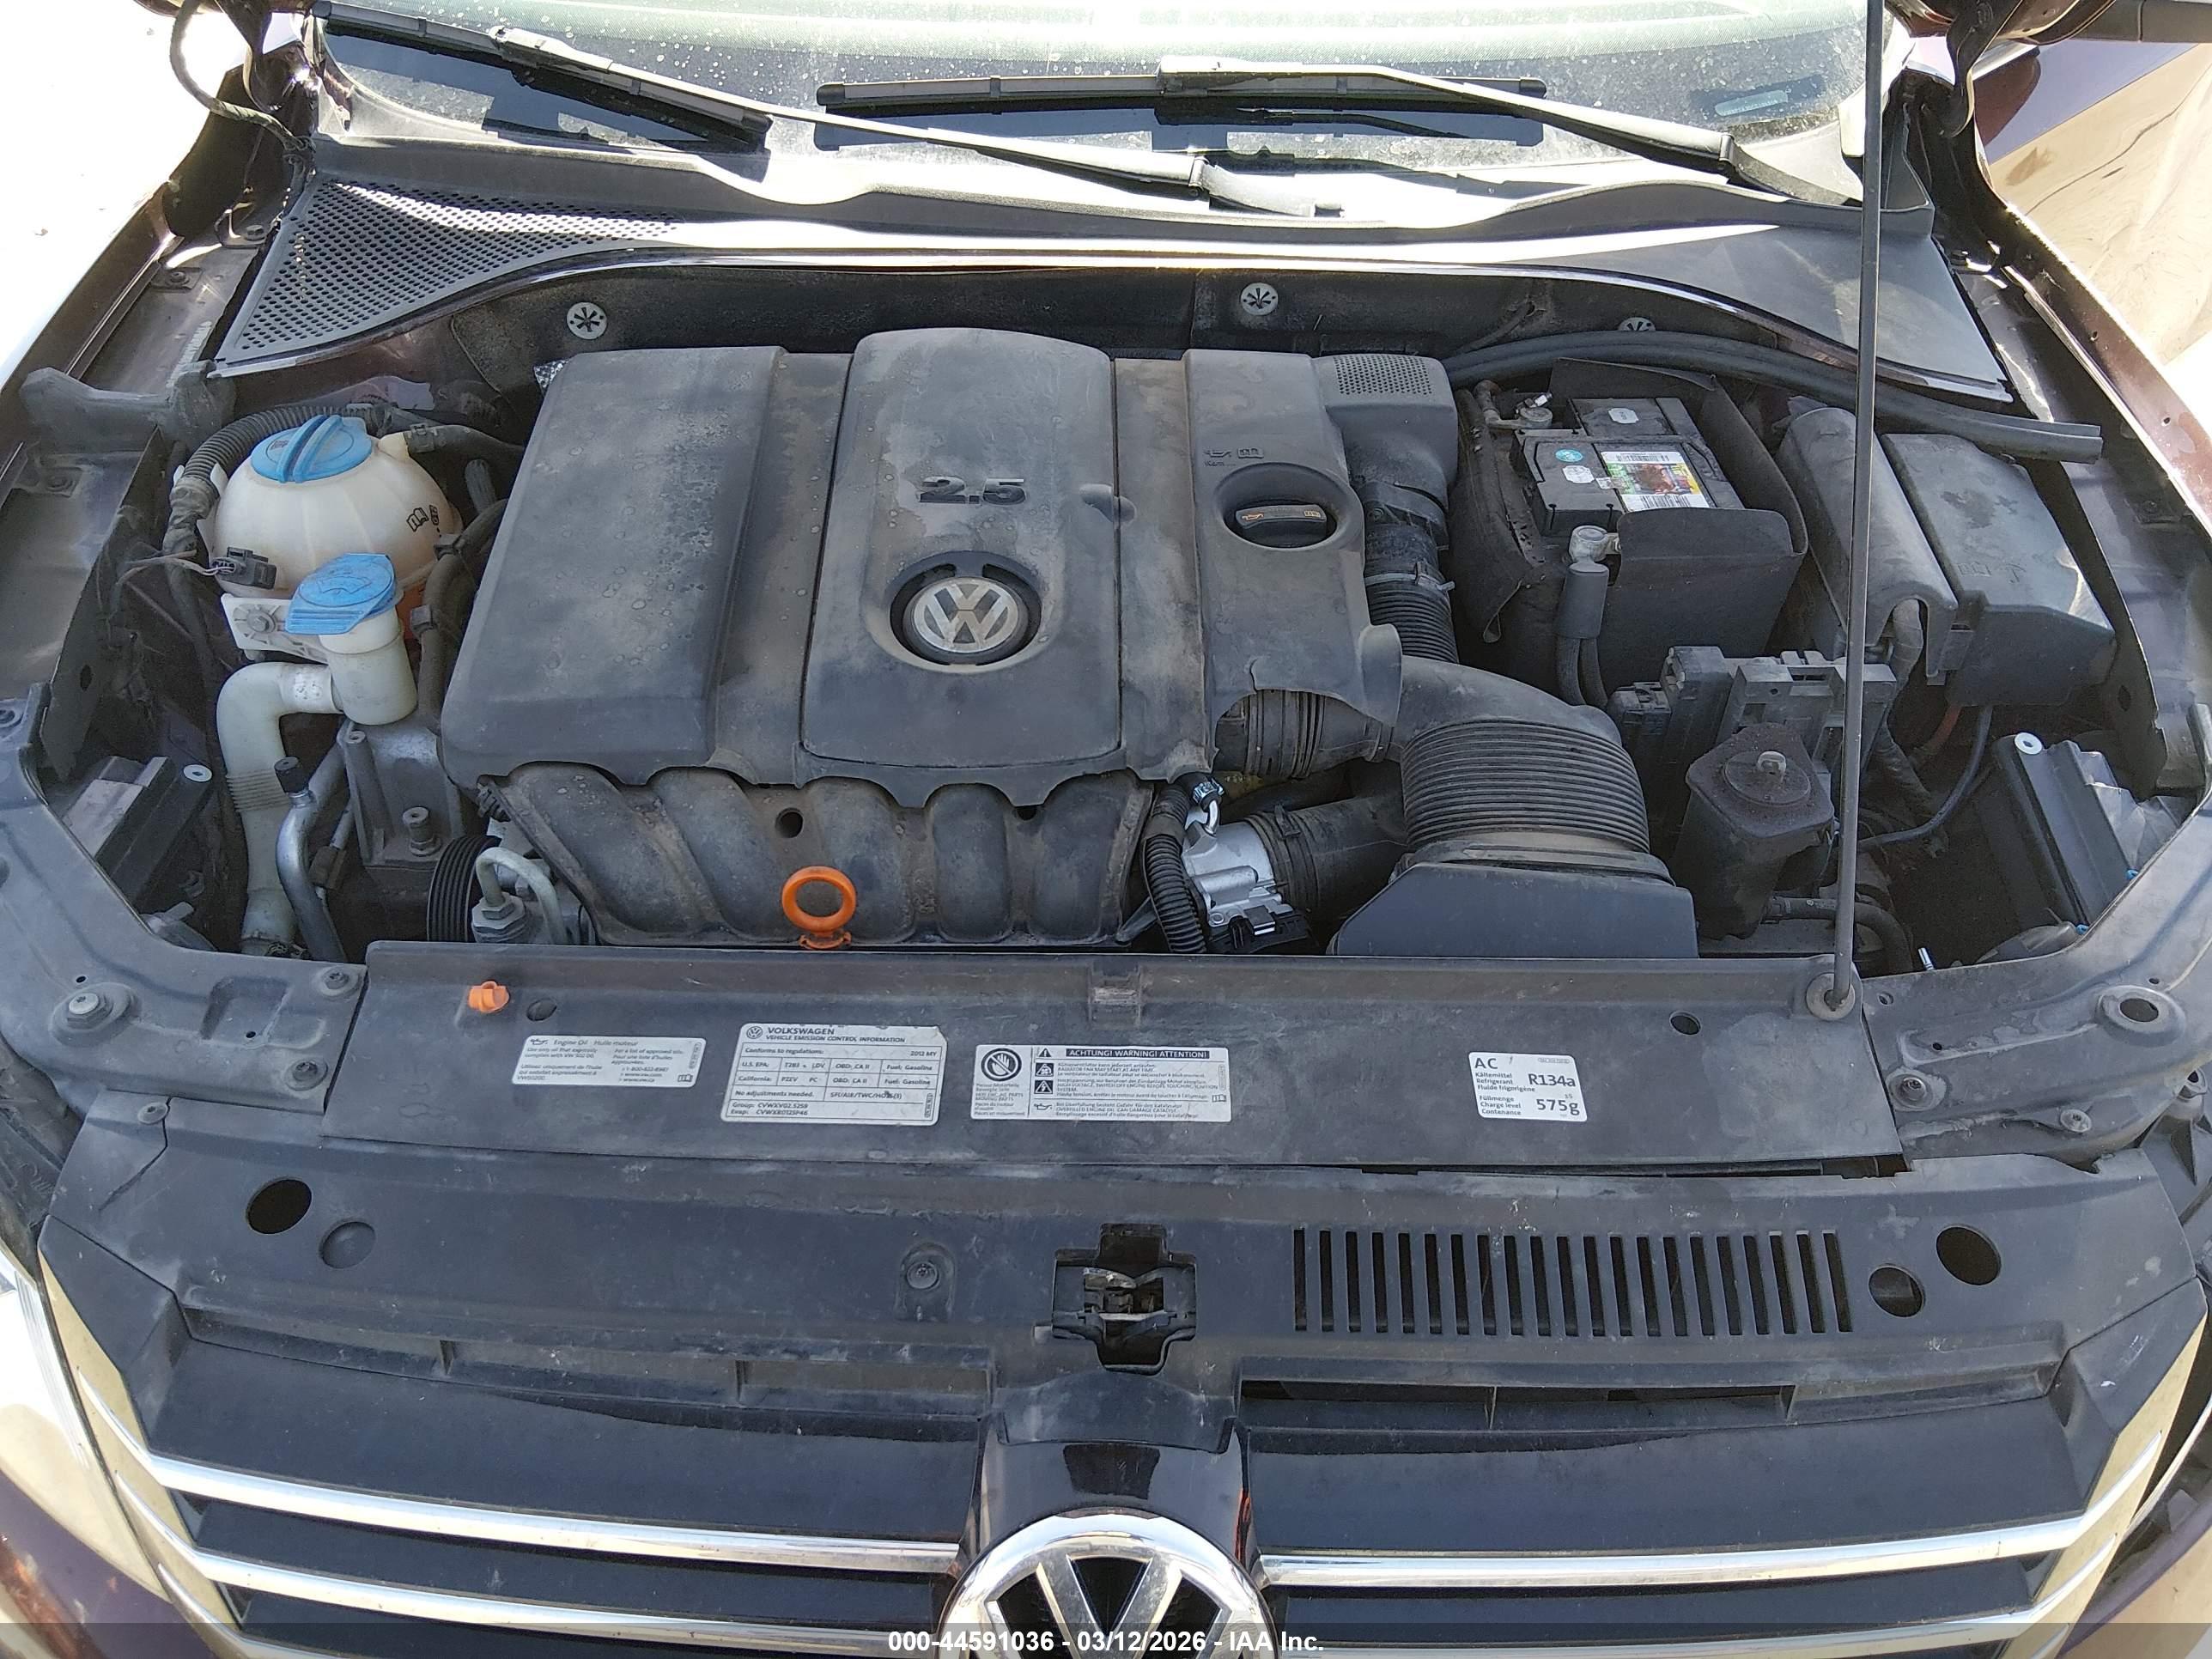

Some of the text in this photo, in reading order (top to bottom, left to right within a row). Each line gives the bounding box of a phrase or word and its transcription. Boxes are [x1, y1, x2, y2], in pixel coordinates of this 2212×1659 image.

[920, 476, 1026, 506] 2.5
[1474, 1057, 1498, 1069] AC
[1528, 1073, 1576, 1087] R134a
[1536, 1098, 1580, 1115] 575g
